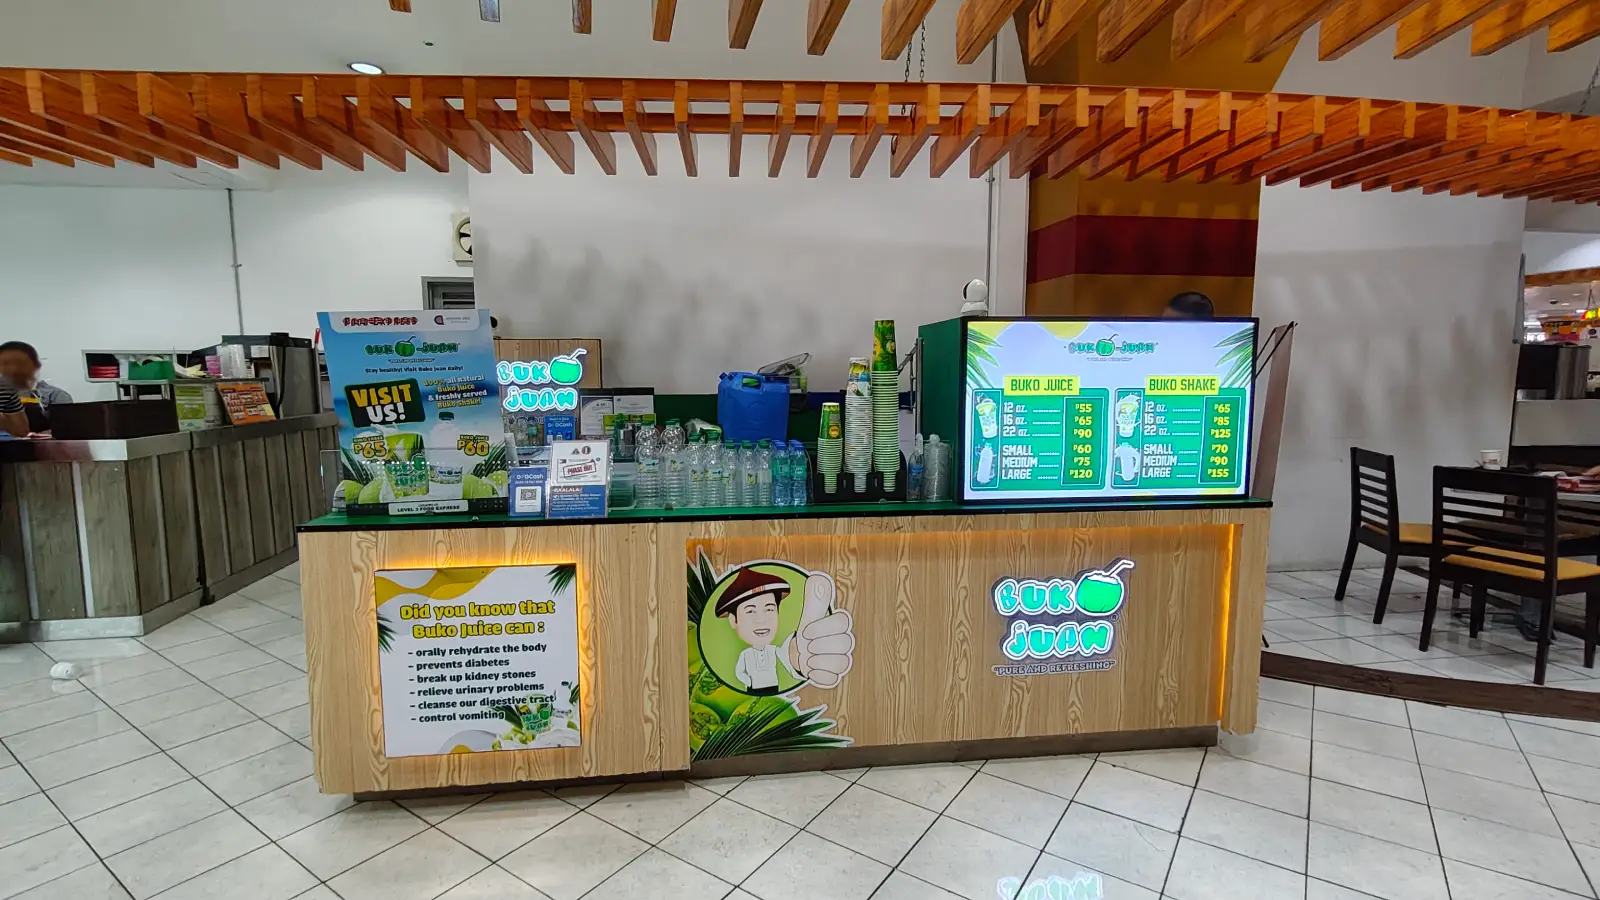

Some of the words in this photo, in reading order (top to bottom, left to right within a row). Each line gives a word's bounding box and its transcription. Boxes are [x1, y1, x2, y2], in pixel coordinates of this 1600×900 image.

[447, 376, 457, 385] all
[457, 374, 485, 384] natural
[1010, 379, 1040, 391] BUKO
[1044, 379, 1074, 391] JUICE
[1149, 379, 1177, 391] BUKO
[1180, 379, 1216, 391] SHAKE
[437, 385, 456, 393] Buko
[351, 384, 413, 408] VISIT
[428, 394, 435, 402] &
[435, 392, 461, 402] freshly
[462, 389, 488, 399] served
[503, 386, 578, 412] JUAN
[437, 400, 457, 409] Buko
[1003, 402, 1014, 413] 12
[1144, 401, 1155, 412] 12
[366, 402, 406, 424] US!
[1144, 413, 1155, 424] 16
[1003, 414, 1014, 425] 16
[1002, 426, 1016, 437] 22
[1143, 425, 1157, 436] 22
[1002, 444, 1034, 456] SMALL
[1143, 443, 1174, 454] SMALL
[1001, 456, 1038, 468] MEDIUM
[1142, 455, 1178, 466] MEDIUM
[567, 465, 583, 475] PHASE
[1001, 468, 1032, 480] LARGE
[1142, 467, 1172, 478] LARGE
[400, 603, 431, 620] Did
[433, 605, 467, 621] you
[469, 602, 516, 617] know
[518, 600, 556, 615] that
[412, 623, 457, 640] Buko
[459, 621, 502, 639] Juice
[504, 621, 535, 635] can
[1002, 620, 1114, 661] JUAN
[415, 647, 447, 658] orally
[449, 645, 501, 657] rehydrate
[502, 643, 520, 654] the
[522, 642, 547, 655] body
[416, 660, 463, 672] prevents
[465, 657, 510, 668] diabetes
[1025, 664, 1048, 674] AND
[417, 674, 447, 684] break
[449, 674, 463, 683] up
[465, 670, 500, 682] kidney
[501, 670, 536, 680] stones
[417, 687, 453, 697] relieve
[455, 684, 494, 696] urinary
[496, 681, 545, 694] problems
[418, 699, 457, 710] cleanse
[459, 699, 478, 708] our
[479, 695, 527, 708] digestive
[529, 693, 554, 704] tract
[419, 712, 457, 723] control
[458, 710, 505, 721] vomiting
